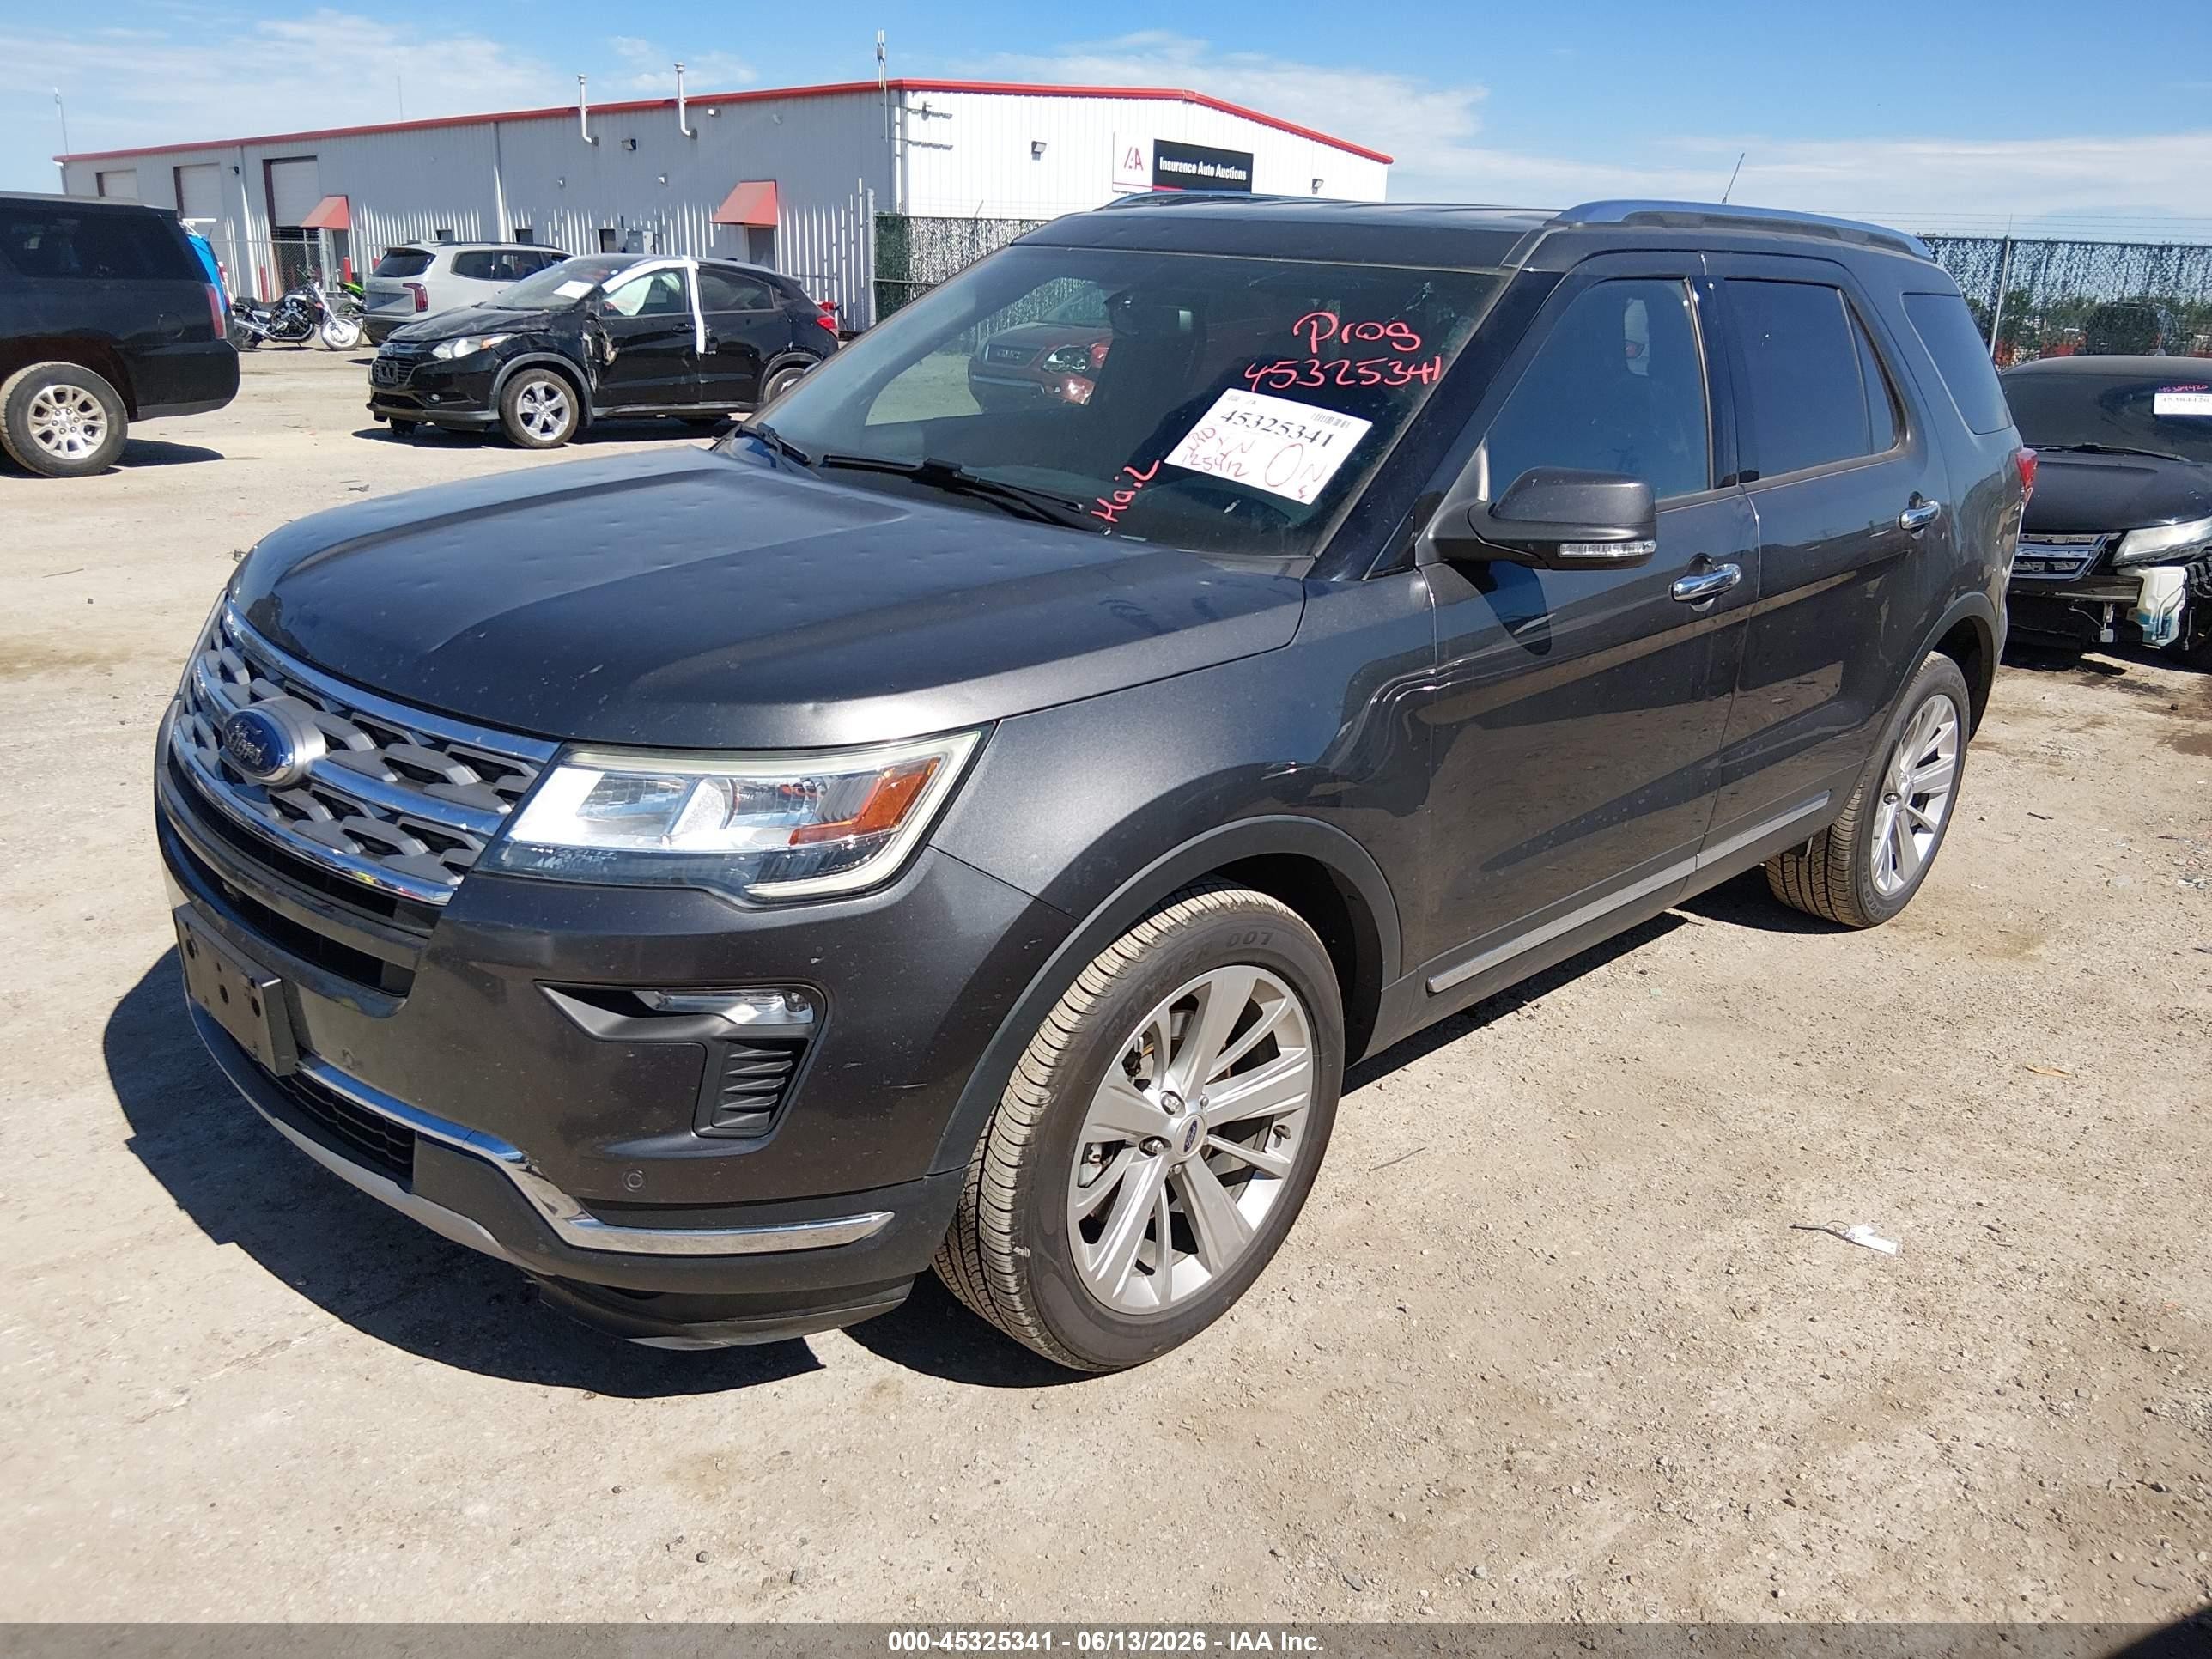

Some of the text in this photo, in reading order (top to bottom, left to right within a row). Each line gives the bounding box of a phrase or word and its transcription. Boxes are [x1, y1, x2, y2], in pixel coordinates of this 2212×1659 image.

[1159, 156, 1247, 180] Insurance Auto Auctions
[1244, 356, 1441, 392] 45325341
[1220, 410, 1334, 447] 45325341
